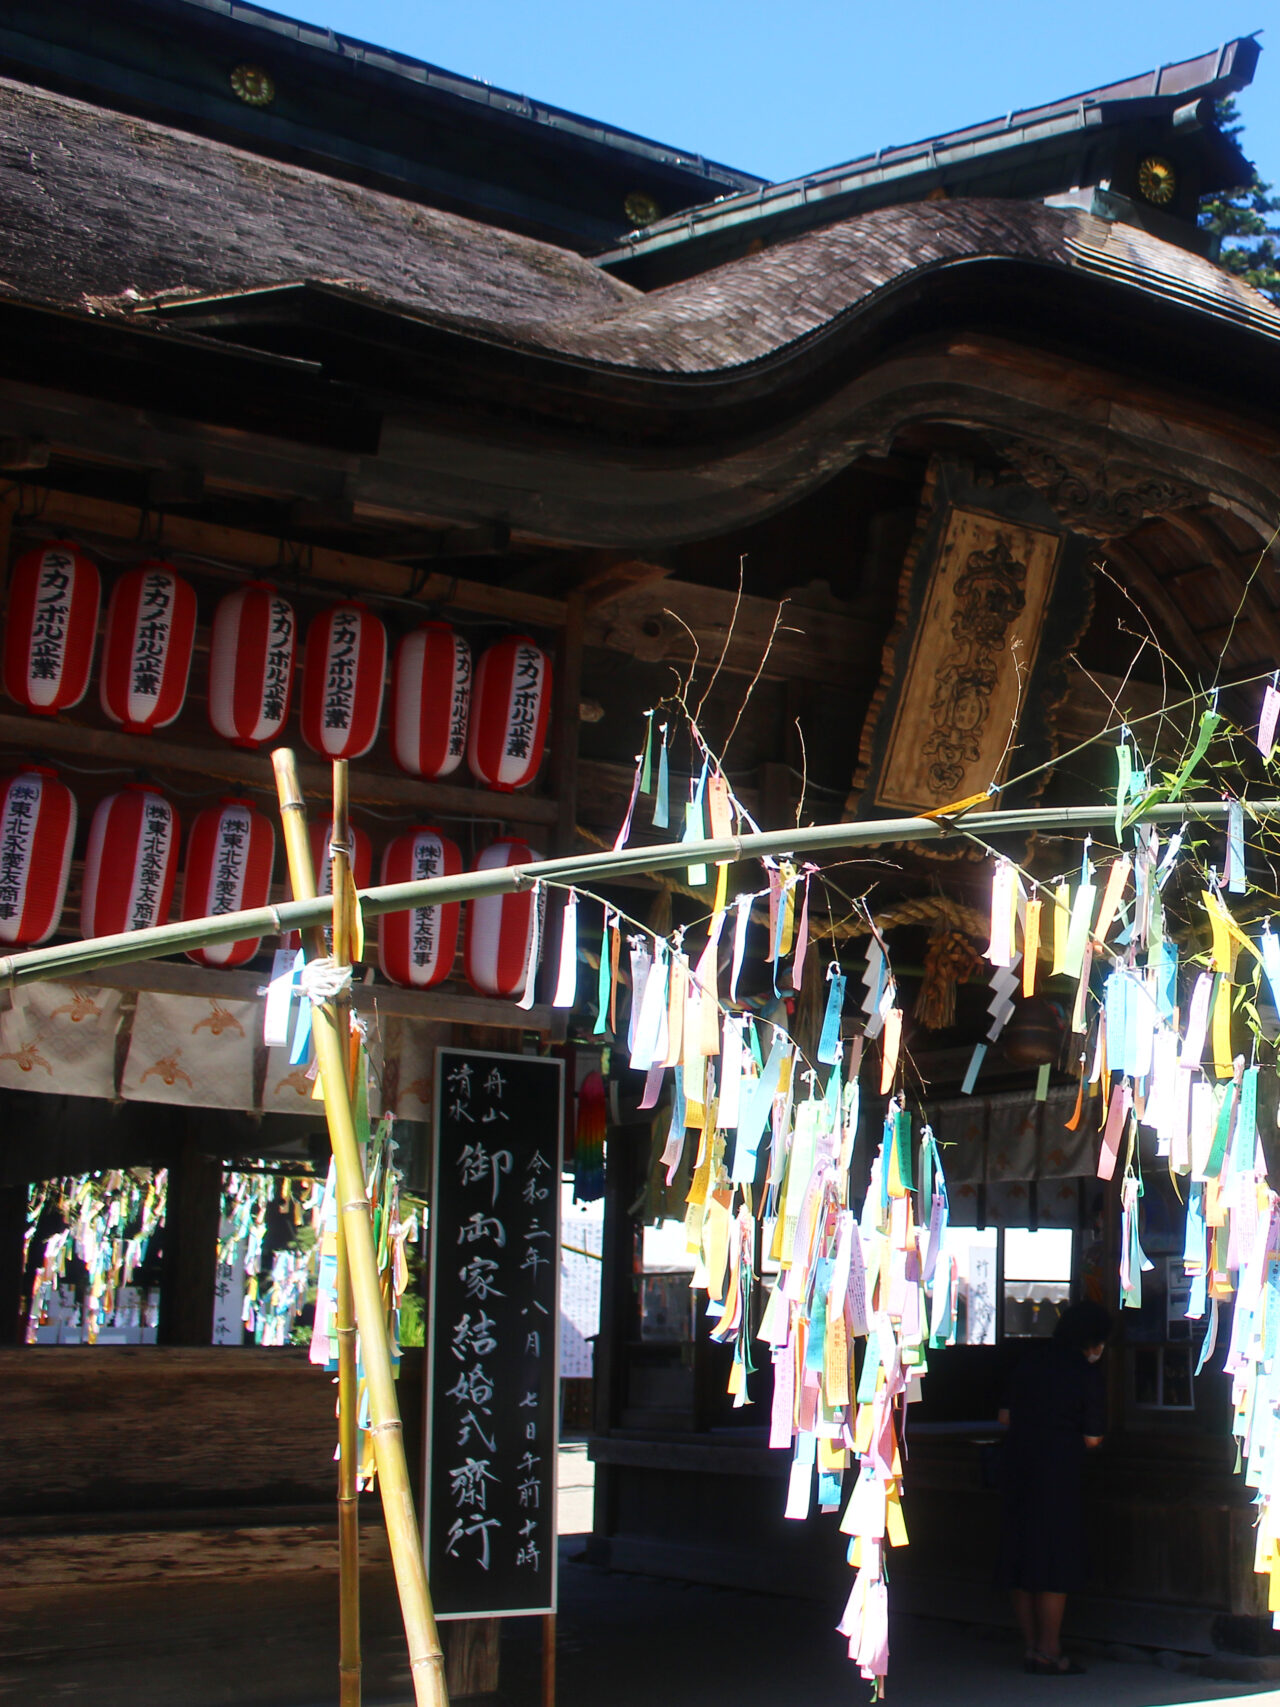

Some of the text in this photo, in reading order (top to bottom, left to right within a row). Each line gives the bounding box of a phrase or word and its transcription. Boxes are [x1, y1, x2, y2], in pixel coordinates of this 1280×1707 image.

[31, 553, 71, 680] タカノボル企業
[133, 573, 172, 696] タカノボル企業
[263, 600, 292, 722] タカノボル企業
[325, 613, 357, 730] タカノボル企業
[506, 647, 541, 760] タカノボル企業
[447, 1062, 476, 1124] 清水
[481, 1066, 510, 1123] 舟山
